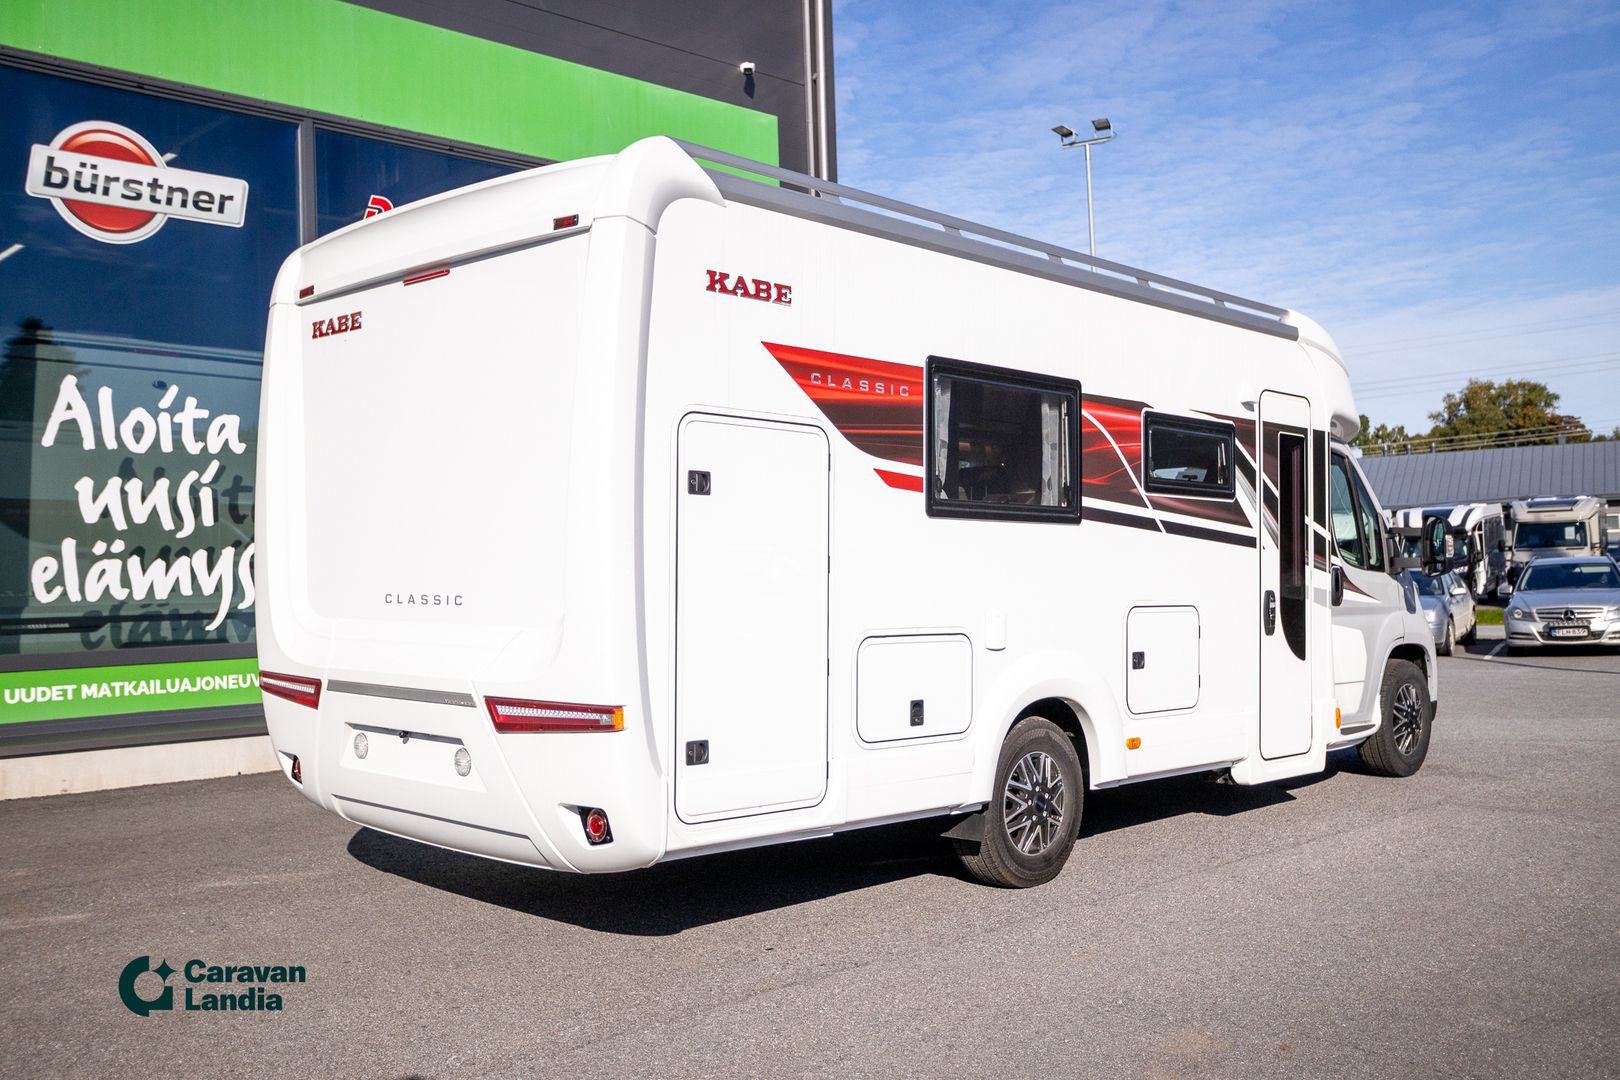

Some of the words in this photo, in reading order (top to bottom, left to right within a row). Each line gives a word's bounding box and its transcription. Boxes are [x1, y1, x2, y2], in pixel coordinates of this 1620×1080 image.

[43, 156, 234, 214] bürstner
[706, 269, 792, 306] KABE
[312, 311, 362, 339] KABE
[810, 372, 909, 397] CLASSIC
[384, 593, 463, 606] CLASSIC
[4, 684, 77, 704] UUDET
